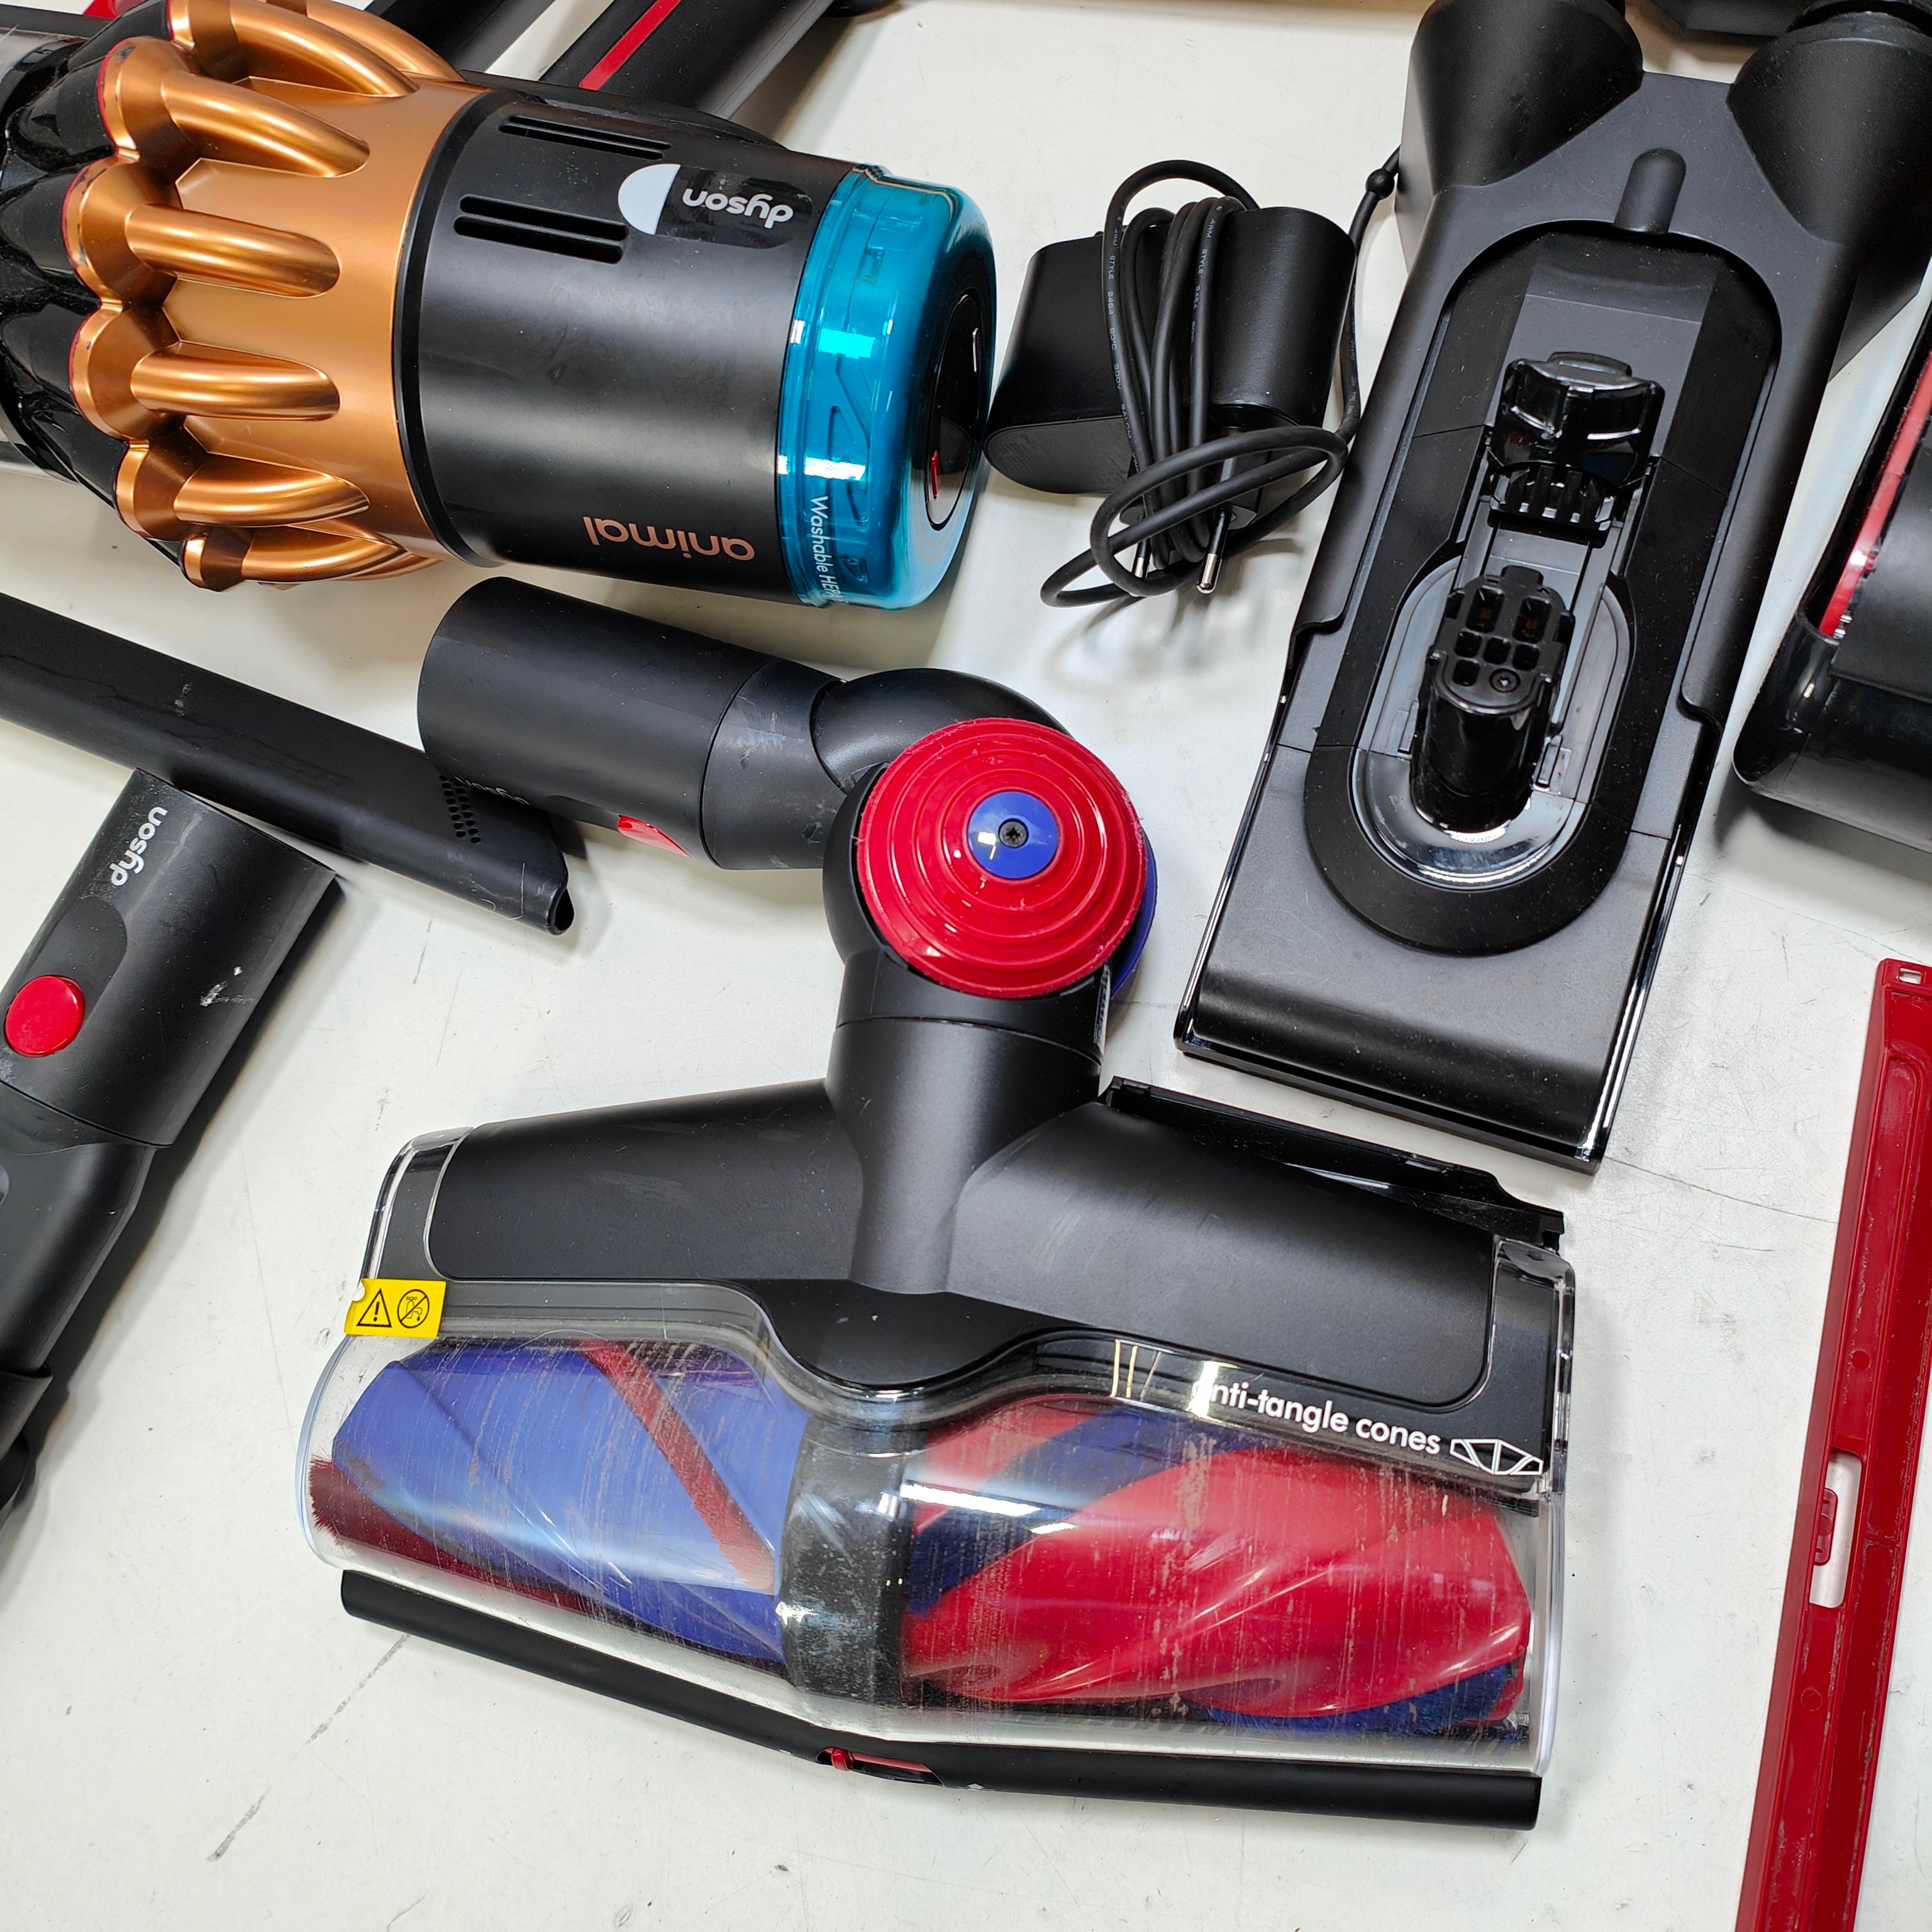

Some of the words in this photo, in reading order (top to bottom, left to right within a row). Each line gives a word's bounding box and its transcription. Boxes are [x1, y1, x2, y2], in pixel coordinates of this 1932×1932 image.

[682, 188, 794, 229] dyson
[1206, 219, 1216, 238] AWM
[1197, 248, 1208, 274] STYLE
[582, 516, 755, 561] animal
[810, 496, 834, 573] Washable
[819, 574, 843, 600] HEPA
[109, 806, 168, 886] dyson
[1355, 1418, 1441, 1455] cones
